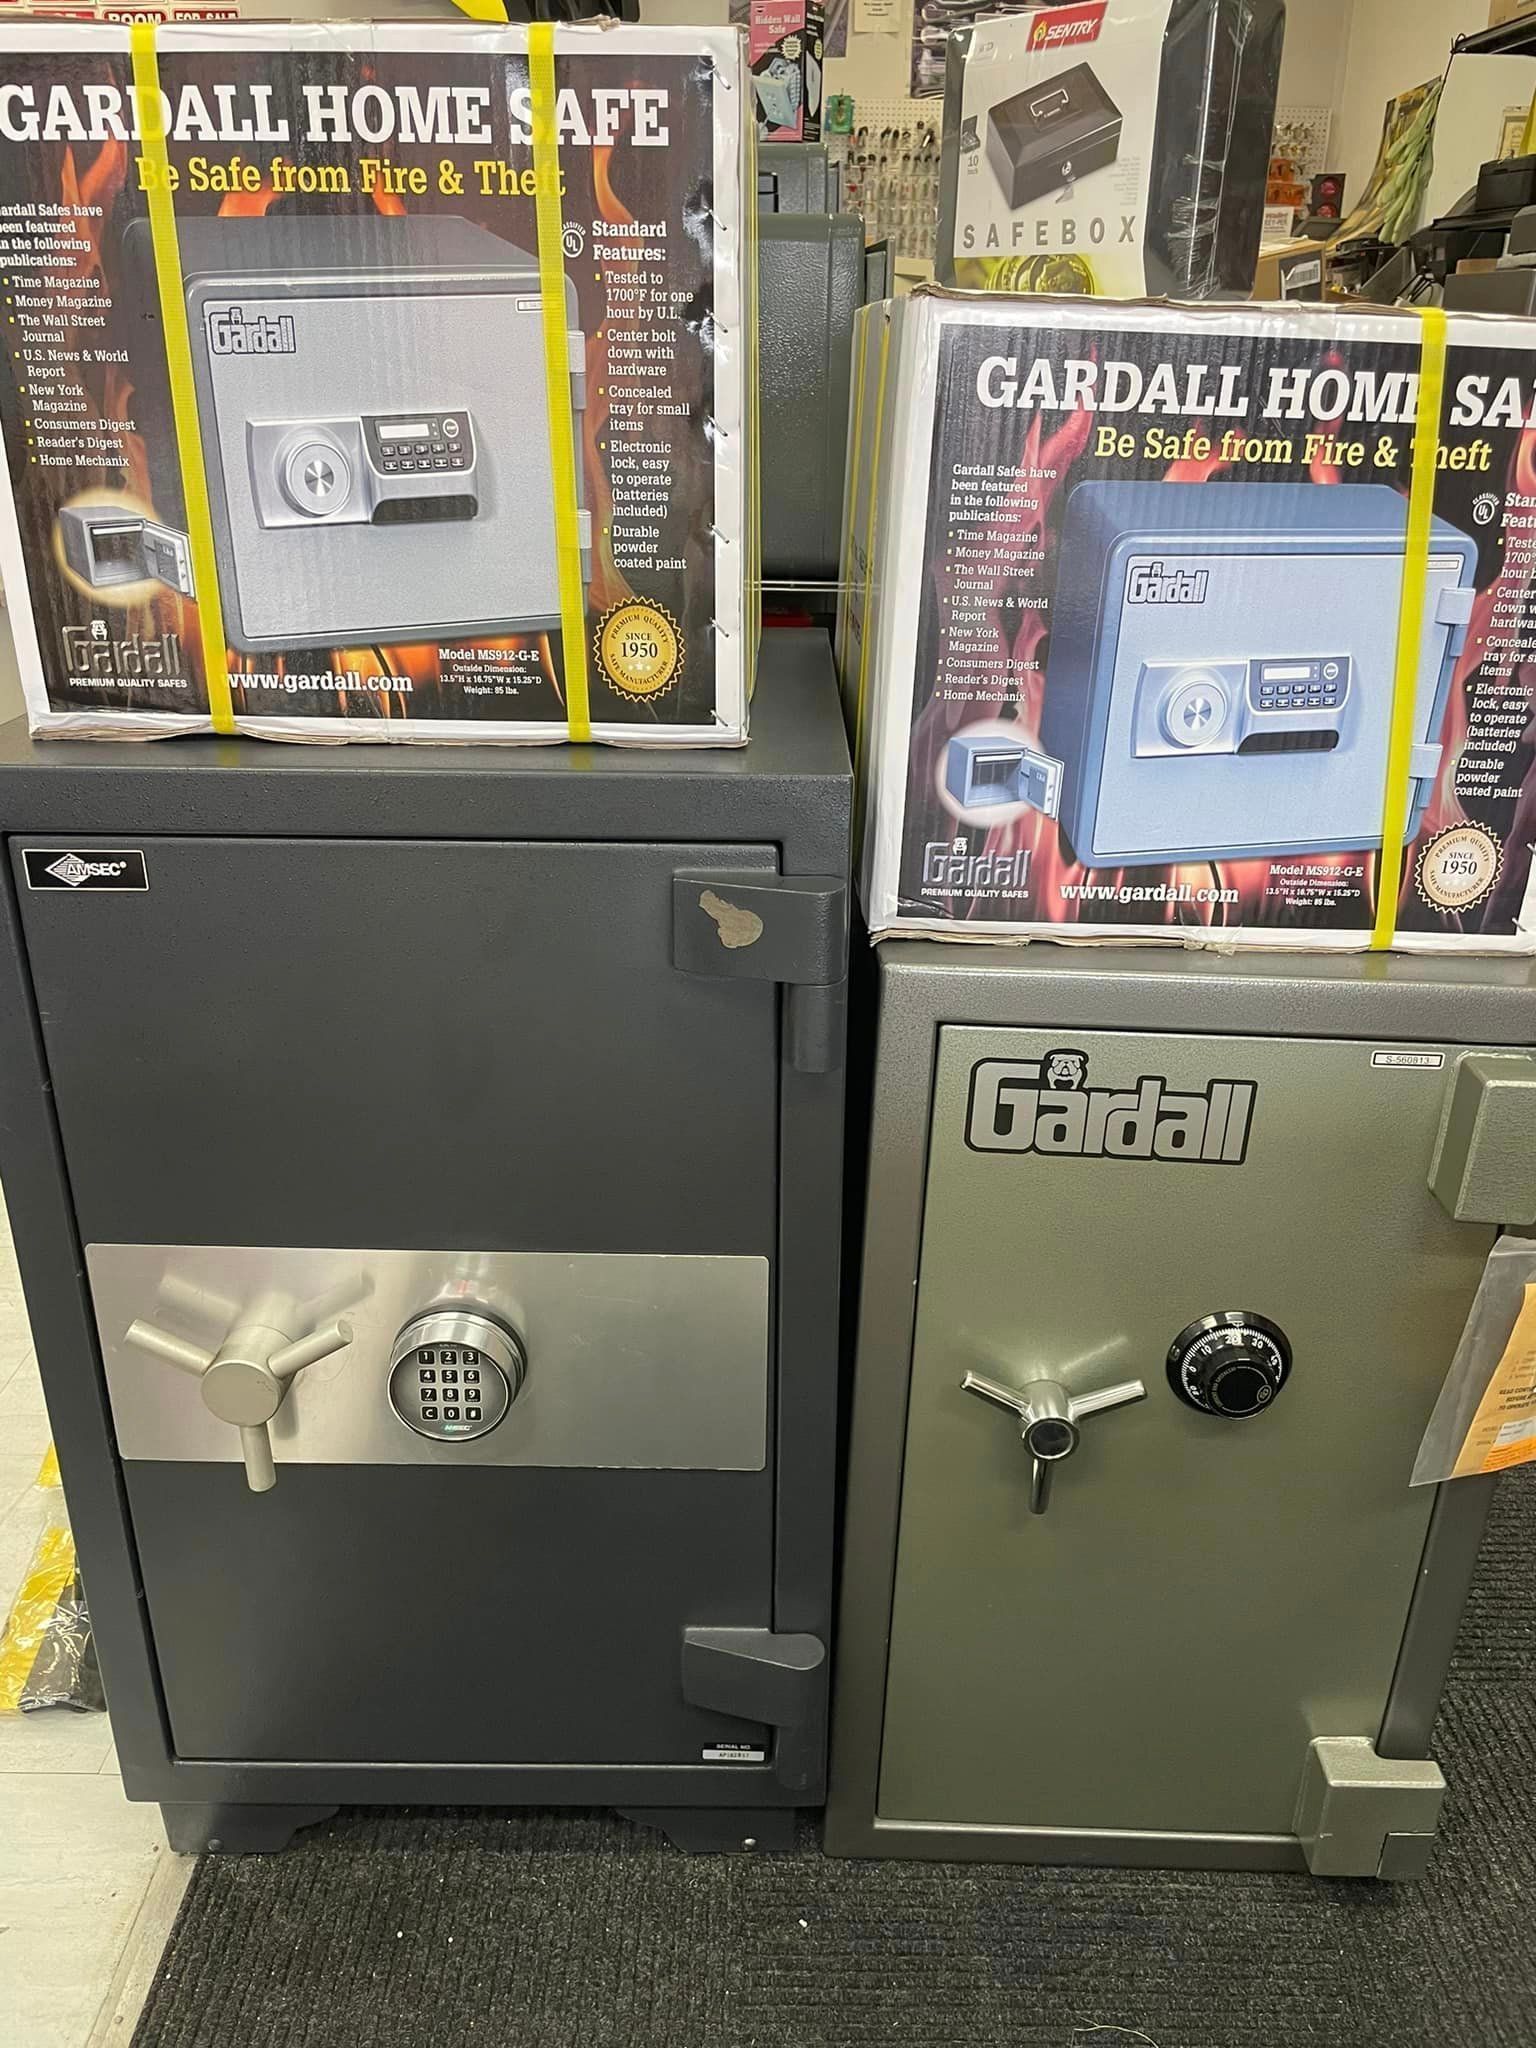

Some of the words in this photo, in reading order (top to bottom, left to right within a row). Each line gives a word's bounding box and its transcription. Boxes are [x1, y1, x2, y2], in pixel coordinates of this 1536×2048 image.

[755, 14, 782, 25] Hidden
[783, 13, 801, 24] Wall
[768, 24, 786, 34] Safe
[1045, 18, 1098, 40] SENTRY
[302, 85, 492, 145] HOME
[510, 87, 670, 146] SAFE
[189, 157, 260, 192] Safe
[270, 157, 350, 193] from
[359, 159, 427, 194] Fire
[439, 160, 464, 194] &
[474, 159, 566, 196] Thet
[592, 220, 667, 238] Standard
[963, 215, 1136, 248] SAFEBOX
[593, 244, 667, 261] Features:
[12, 275, 41, 288] Time
[44, 276, 100, 290] Magazine
[605, 271, 647, 285] Tested
[650, 272, 663, 285] to
[15, 294, 53, 309] Money
[56, 295, 112, 310] Magazine
[606, 288, 647, 302] 1700°F
[651, 288, 667, 302] for
[670, 291, 693, 302] one
[606, 305, 635, 319] hour
[638, 306, 654, 321] by
[657, 306, 681, 319] U.L.
[18, 314, 40, 326] The
[43, 314, 68, 326] Wall
[71, 314, 106, 327] Street
[22, 330, 65, 342] Journal
[208, 309, 297, 355] Gardall
[607, 329, 649, 342] Center
[651, 329, 677, 342] bolt
[23, 350, 45, 361] U.S.
[48, 350, 80, 361] News
[82, 350, 92, 361] &
[94, 350, 129, 362] World
[607, 346, 643, 359] down
[646, 346, 675, 359] with
[27, 365, 65, 379] Report
[608, 362, 667, 376] hardware
[28, 384, 55, 396] New
[57, 384, 84, 396] York
[608, 385, 672, 398] Concealed
[976, 356, 1249, 417] GARDALL
[1449, 375, 1536, 429] SA
[32, 400, 88, 413] Magazine
[609, 402, 634, 418] tray
[637, 402, 654, 415] for
[656, 402, 690, 415] small
[34, 418, 97, 430] Consumers
[99, 418, 136, 432] Digest
[610, 418, 644, 431] items
[36, 436, 84, 448] Reader's
[87, 437, 123, 450] Digest
[610, 440, 672, 453] Electronic
[1094, 425, 1135, 458] Be
[1143, 427, 1211, 460] Safe
[1218, 430, 1293, 465] from
[1301, 434, 1364, 467] Fire
[1373, 436, 1398, 468] &
[1409, 439, 1493, 472] heft
[39, 454, 73, 466] Home
[75, 455, 130, 467] Mechanix
[611, 455, 639, 470] lock,
[642, 459, 670, 472] easy
[953, 463, 994, 476] Gardall
[996, 465, 1027, 477] Safes
[1029, 466, 1057, 479] have
[611, 473, 624, 484] to
[626, 473, 672, 487] operate
[951, 479, 979, 490] been
[981, 480, 1028, 492] featured
[611, 488, 669, 502] (batteries
[950, 494, 961, 505] in
[964, 495, 982, 506] the
[985, 495, 1038, 510] following
[612, 504, 668, 519] included)
[949, 510, 1021, 523] publications:
[612, 525, 660, 537] Durable
[957, 529, 983, 541] Time
[986, 530, 1038, 544] Magazine
[613, 540, 658, 555] powder
[955, 547, 991, 560] Money
[994, 548, 1045, 562] Magazine
[613, 556, 653, 568] coated
[655, 557, 687, 571] paint
[954, 563, 974, 575] The
[977, 564, 1000, 576] Wall
[1003, 565, 1034, 577] Street
[954, 579, 993, 590] Journal
[1127, 565, 1210, 604] Gardall
[951, 596, 971, 607] U.S.
[974, 596, 1003, 608] News
[1005, 597, 1014, 608] &
[1017, 597, 1048, 609] World
[951, 610, 986, 623] Report
[625, 632, 652, 641] SINCE
[949, 627, 972, 638] New
[975, 627, 999, 638] York
[439, 648, 475, 660] Model
[477, 649, 540, 661] MS912-G-E
[621, 642, 658, 658] 1950
[949, 641, 999, 654] Magazine
[946, 657, 1003, 669] Consumers
[1006, 658, 1040, 671] Digest
[69, 677, 115, 687] PREMIUM
[117, 678, 155, 688] QUALITY
[158, 679, 188, 688] SAFES
[226, 671, 414, 693] www.gardall.com
[945, 673, 988, 685] Reader's
[991, 674, 1024, 687] Digest
[943, 690, 973, 700] Home
[976, 690, 1025, 702] Mechanix
[1475, 683, 1533, 697] Electronic
[1472, 698, 1499, 711] lock,
[1502, 701, 1529, 712] easy
[1469, 712, 1482, 723] to
[1483, 713, 1527, 726] operate
[1466, 725, 1521, 739] (batteries
[1463, 739, 1517, 754] included)
[1459, 757, 1504, 770] Durable
[1456, 772, 1500, 785] powder
[1454, 785, 1491, 797] coated
[1493, 786, 1523, 799] paint
[1441, 860, 1478, 875] 1950
[1059, 883, 1239, 904] www.gardall.com
[964, 1056, 1258, 1165] Gardall
[445, 1352, 452, 1361] 2
[467, 1352, 474, 1361] 3
[423, 1371, 431, 1379] 4
[446, 1371, 453, 1379] 5
[468, 1371, 475, 1380] 6
[425, 1390, 432, 1398] 7
[447, 1390, 454, 1398] 8
[468, 1390, 475, 1398] 9
[425, 1409, 433, 1418] C
[447, 1409, 455, 1418] 0
